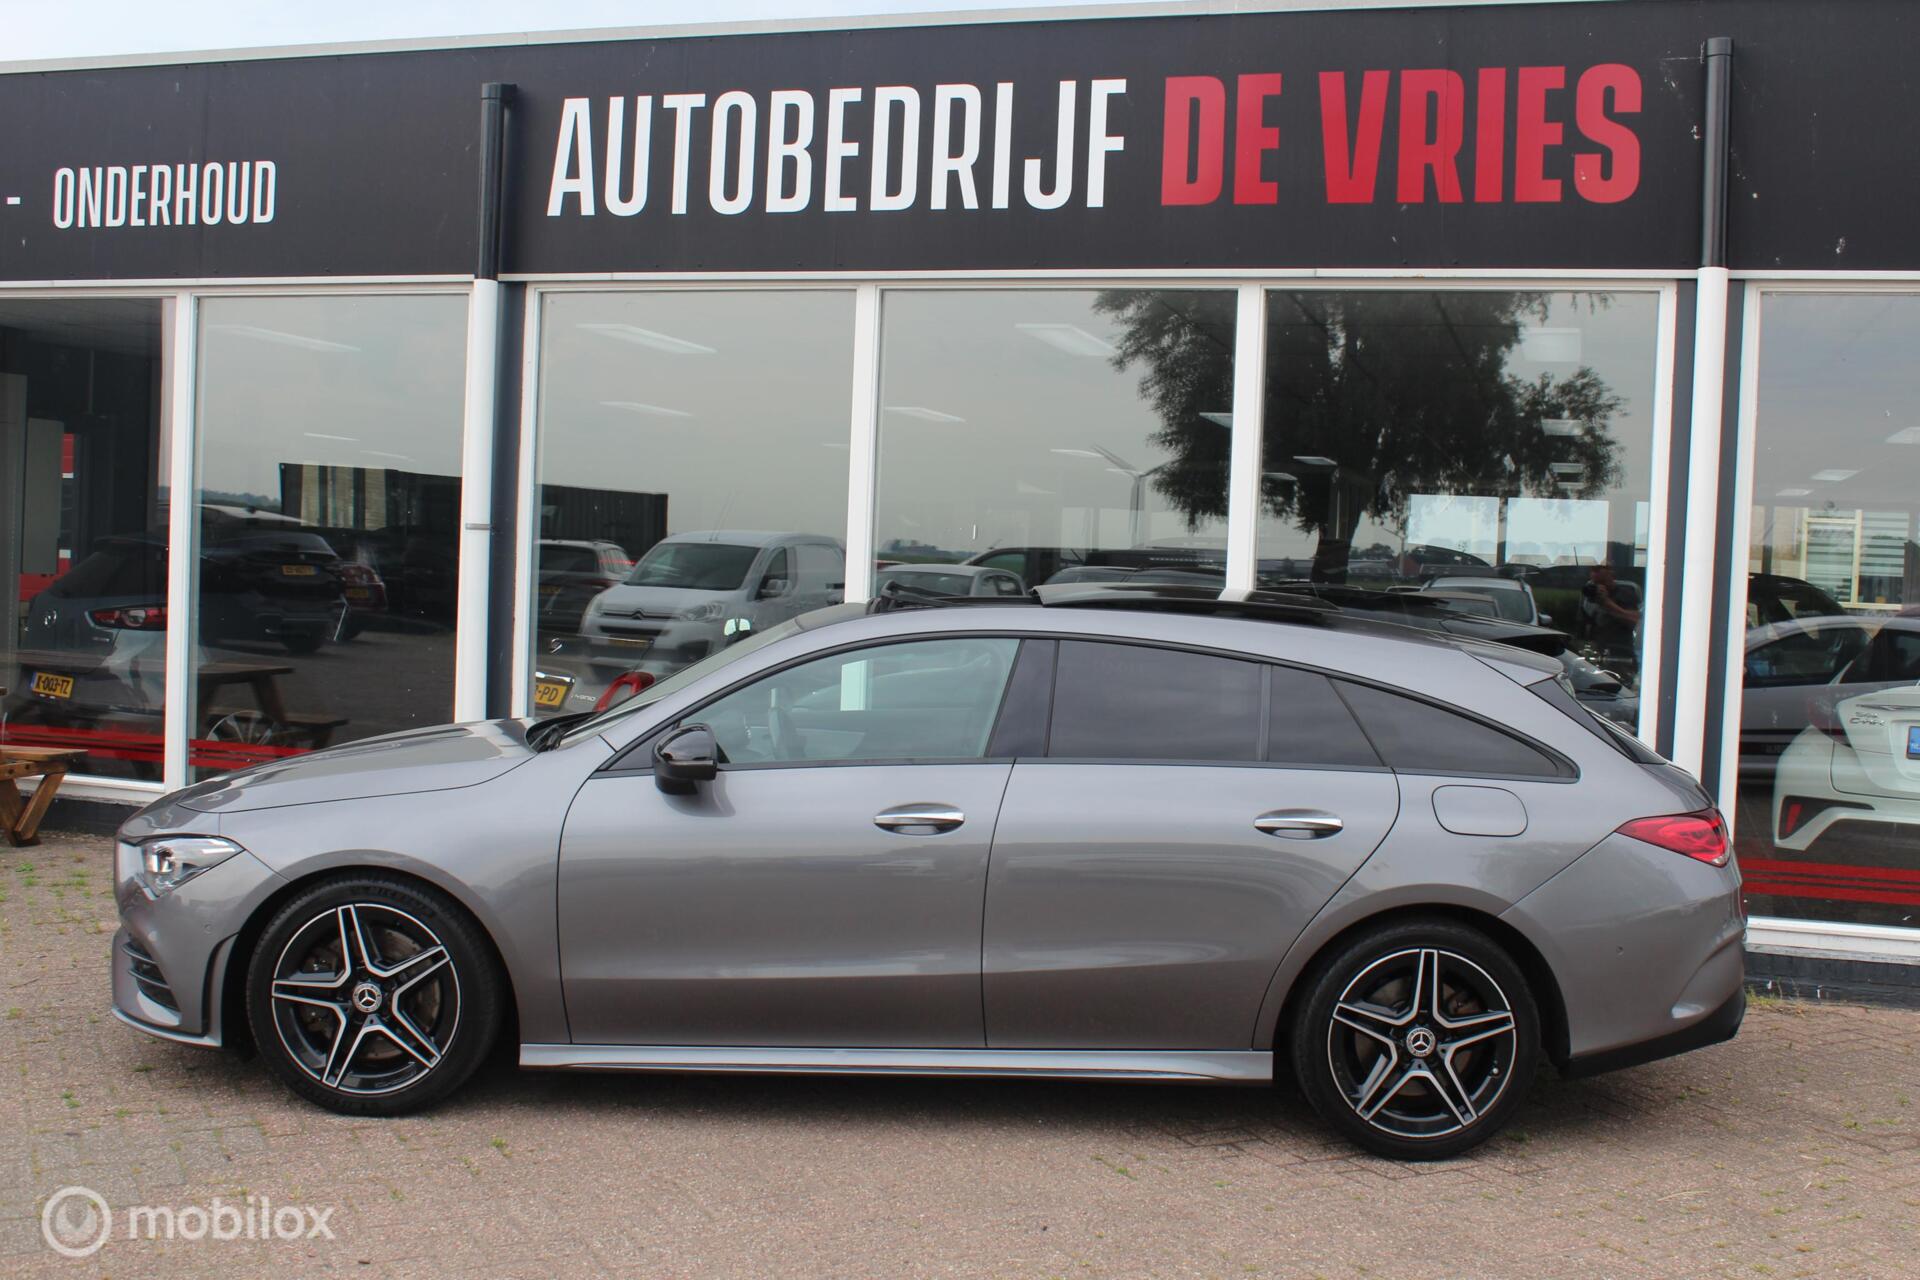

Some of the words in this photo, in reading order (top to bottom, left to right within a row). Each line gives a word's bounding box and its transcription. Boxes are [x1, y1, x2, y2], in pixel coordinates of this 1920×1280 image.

[53, 160, 277, 229] ONDERHOUD
[546, 78, 1127, 217] AUTOBEDRIJF
[1161, 73, 1283, 206] DE
[1318, 63, 1643, 204] VRIES
